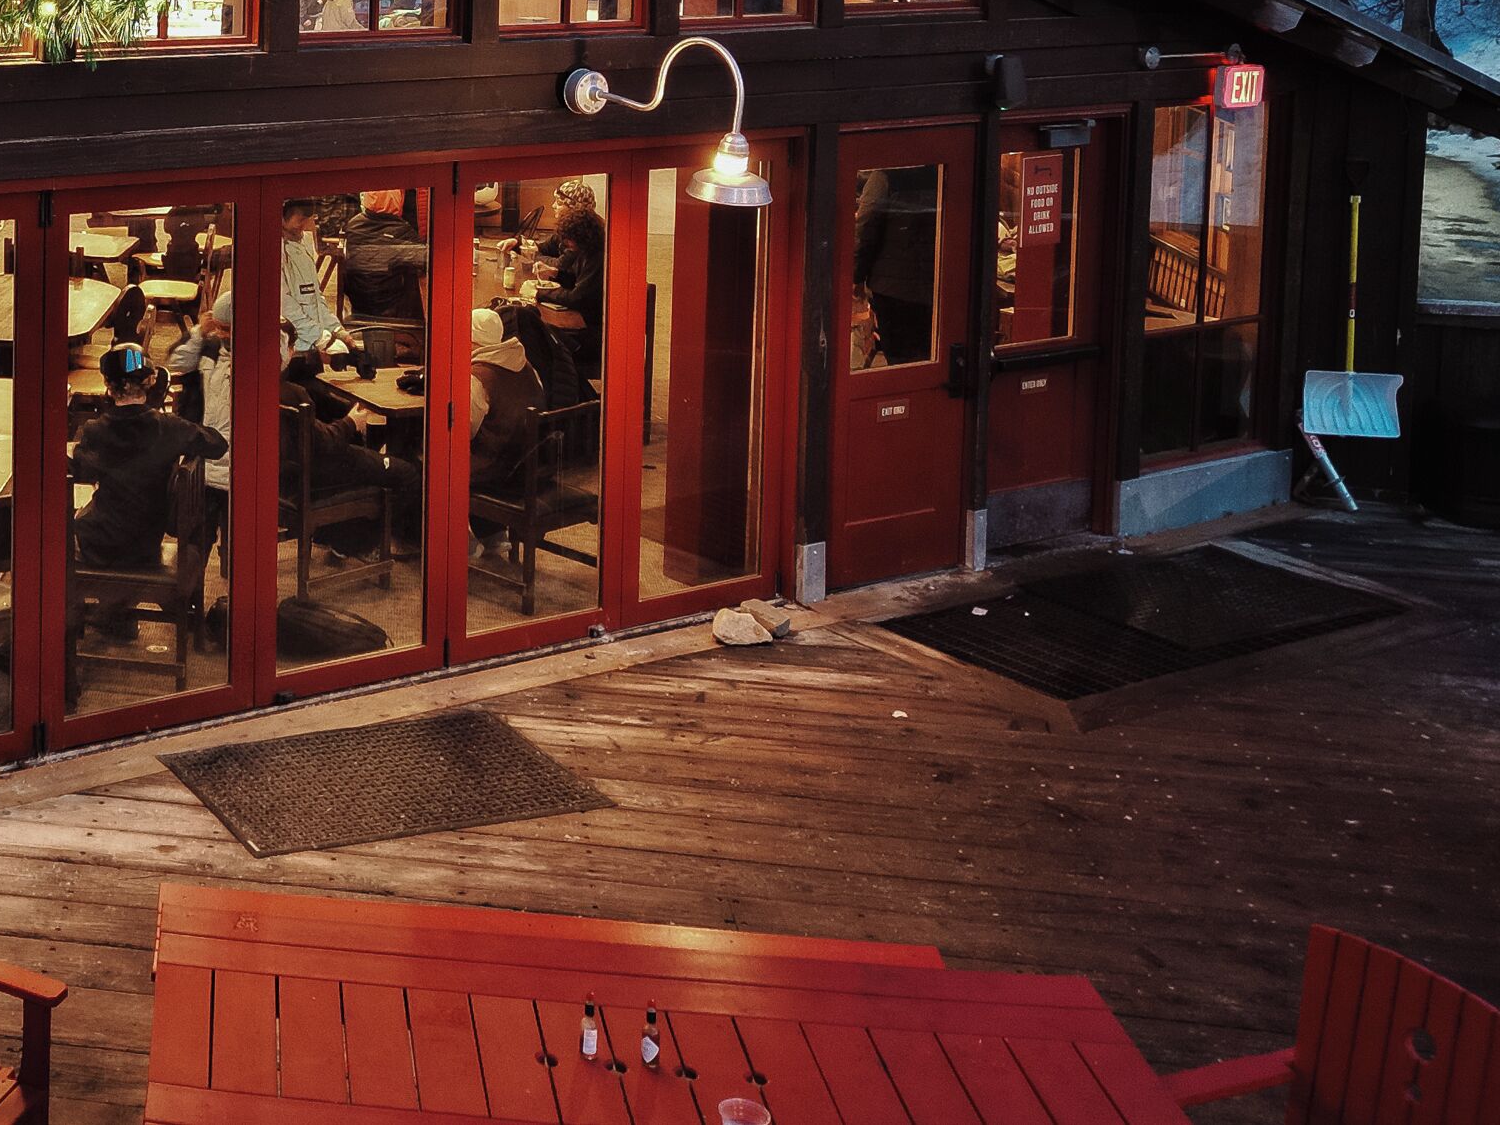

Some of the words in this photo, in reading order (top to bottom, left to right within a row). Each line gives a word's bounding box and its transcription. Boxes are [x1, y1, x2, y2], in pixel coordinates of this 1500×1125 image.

[1231, 70, 1260, 104] EXIT
[1026, 186, 1035, 196] NO
[1035, 183, 1059, 195] OUTSIDE
[1030, 198, 1045, 208] FOOD
[1045, 197, 1054, 207] OR
[1033, 210, 1051, 221] DRINK
[1028, 222, 1054, 235] ALLOWED
